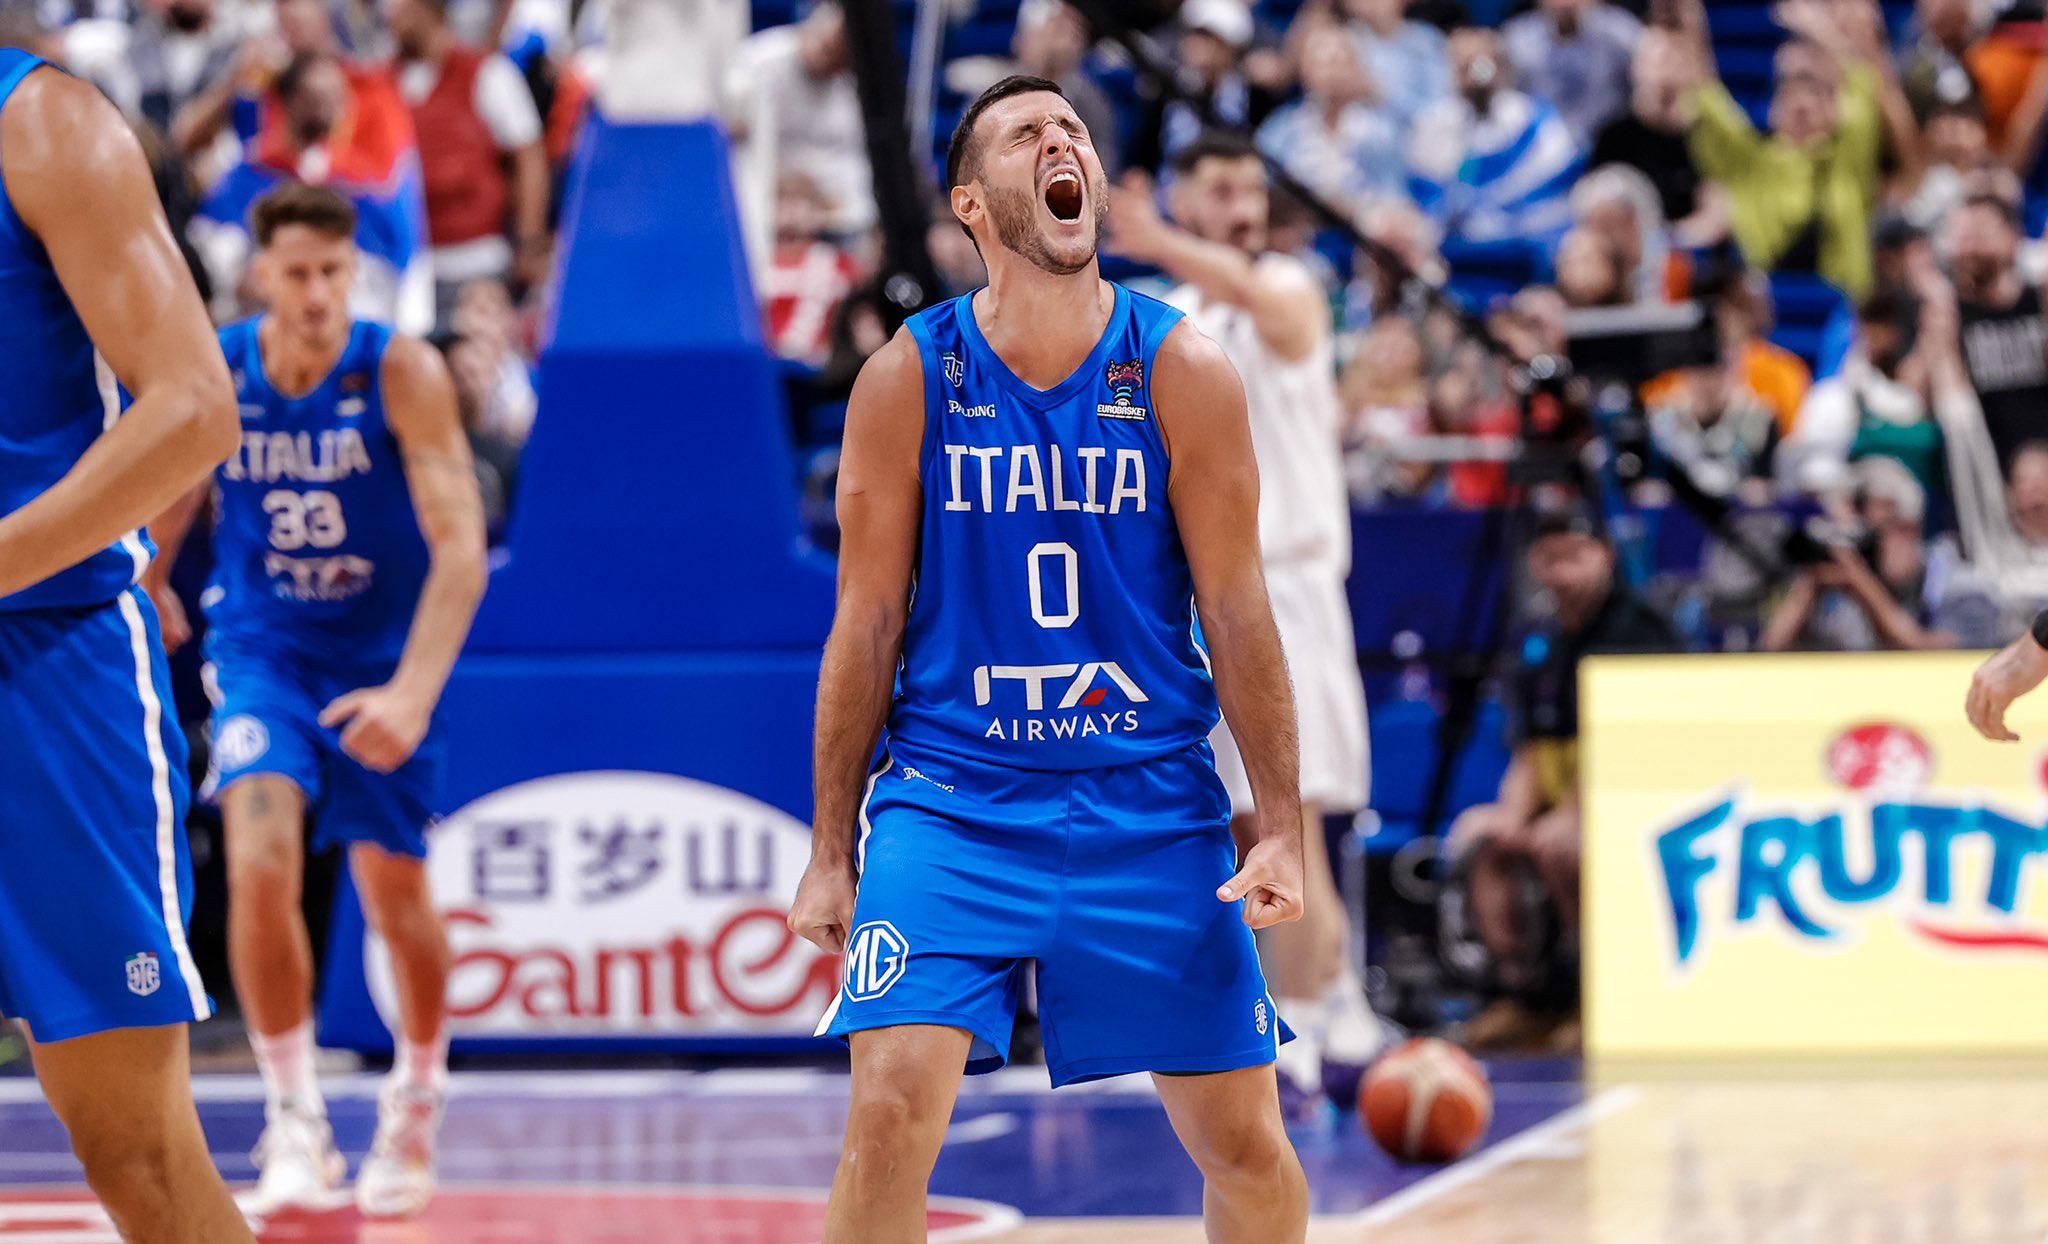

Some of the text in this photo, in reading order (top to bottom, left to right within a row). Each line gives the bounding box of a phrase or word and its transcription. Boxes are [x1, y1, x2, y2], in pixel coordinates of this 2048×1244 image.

[1096, 404, 1147, 417] EUROBASKET
[944, 444, 1147, 514] ITALIA
[261, 489, 347, 550] 33
[1027, 542, 1080, 628] 0
[973, 661, 1150, 710] ITA
[984, 710, 1139, 742] AIRWAYS
[473, 816, 773, 904] 百岁山
[846, 926, 901, 995] MG
